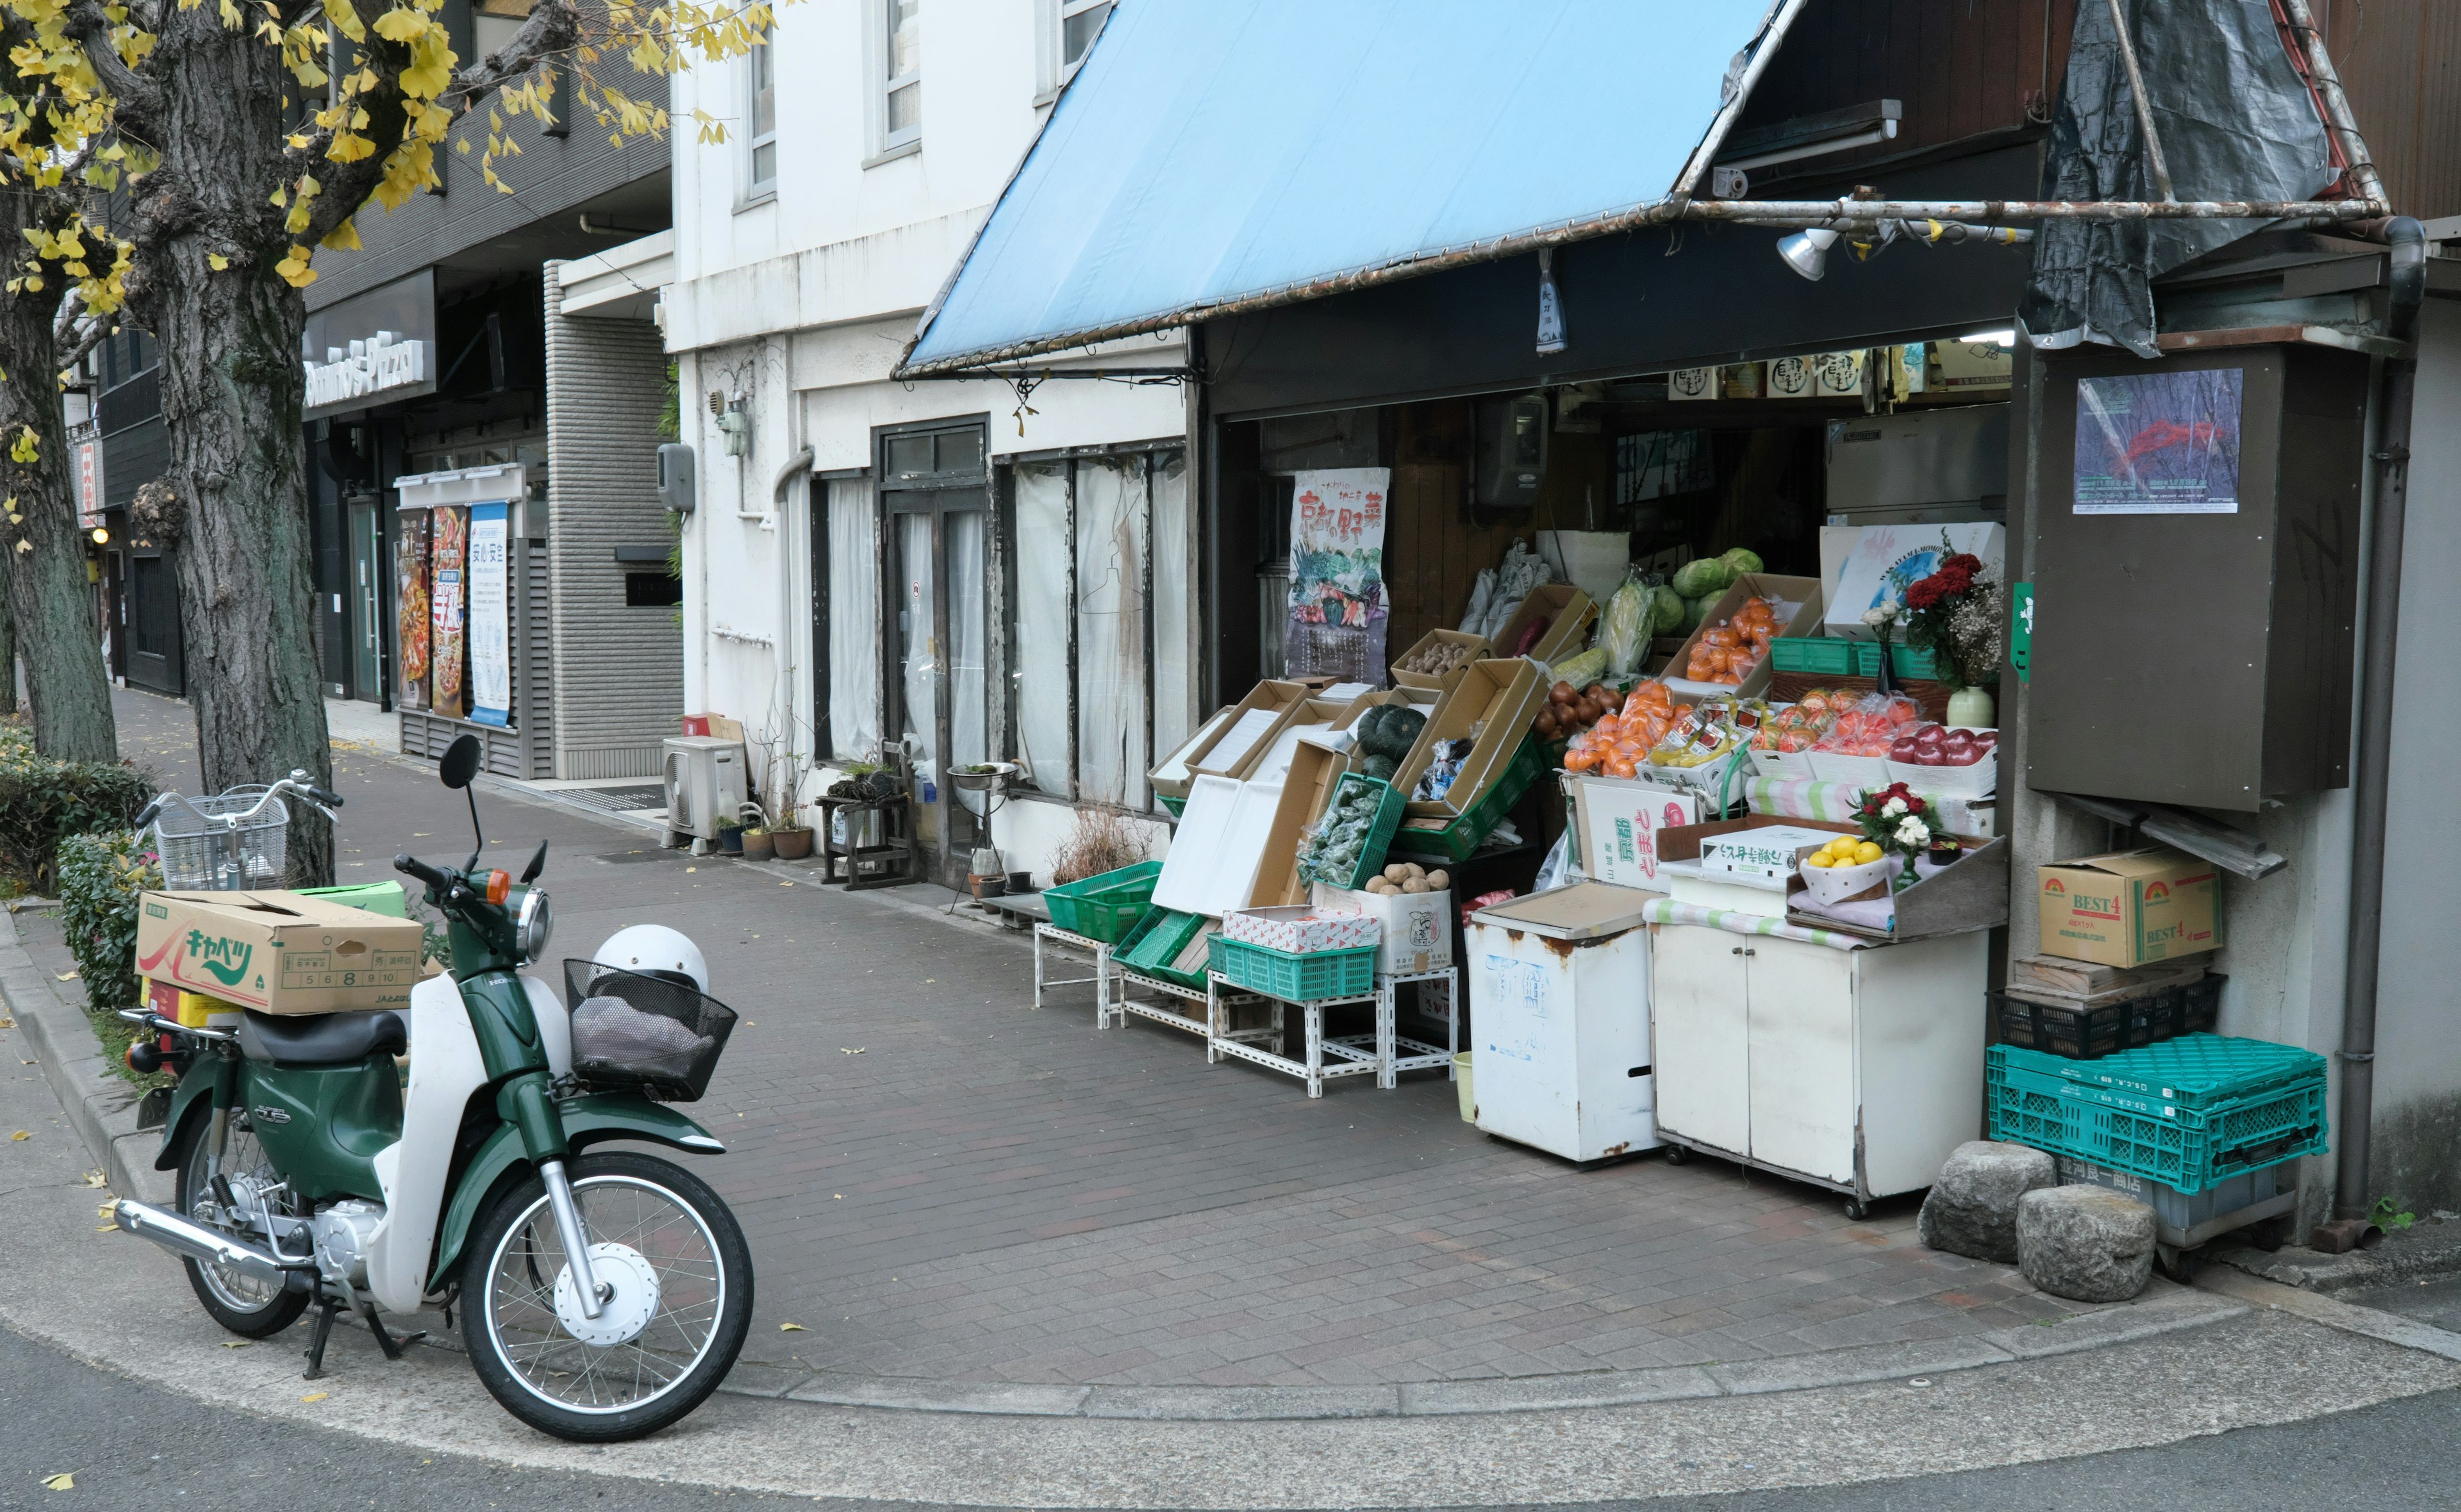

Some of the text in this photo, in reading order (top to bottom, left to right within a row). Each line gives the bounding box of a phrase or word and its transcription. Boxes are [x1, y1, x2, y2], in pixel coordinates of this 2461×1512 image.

[366, 331, 424, 393] Pizza
[1298, 489, 1382, 545] 京都の野菜
[433, 583, 461, 629] 半額
[1614, 817, 1634, 863] 京都
[1635, 809, 1655, 880] とまと
[1720, 843, 1783, 866] 万願寺甘とう
[1605, 842, 1614, 879] 山城産
[2073, 894, 2121, 914] BEST 4
[2148, 920, 2183, 943] BEST 4
[186, 929, 253, 987] キャベツ
[374, 956, 384, 966] 秀
[307, 973, 394, 985] 5 6 8 9 10
[488, 978, 519, 986] HOND
